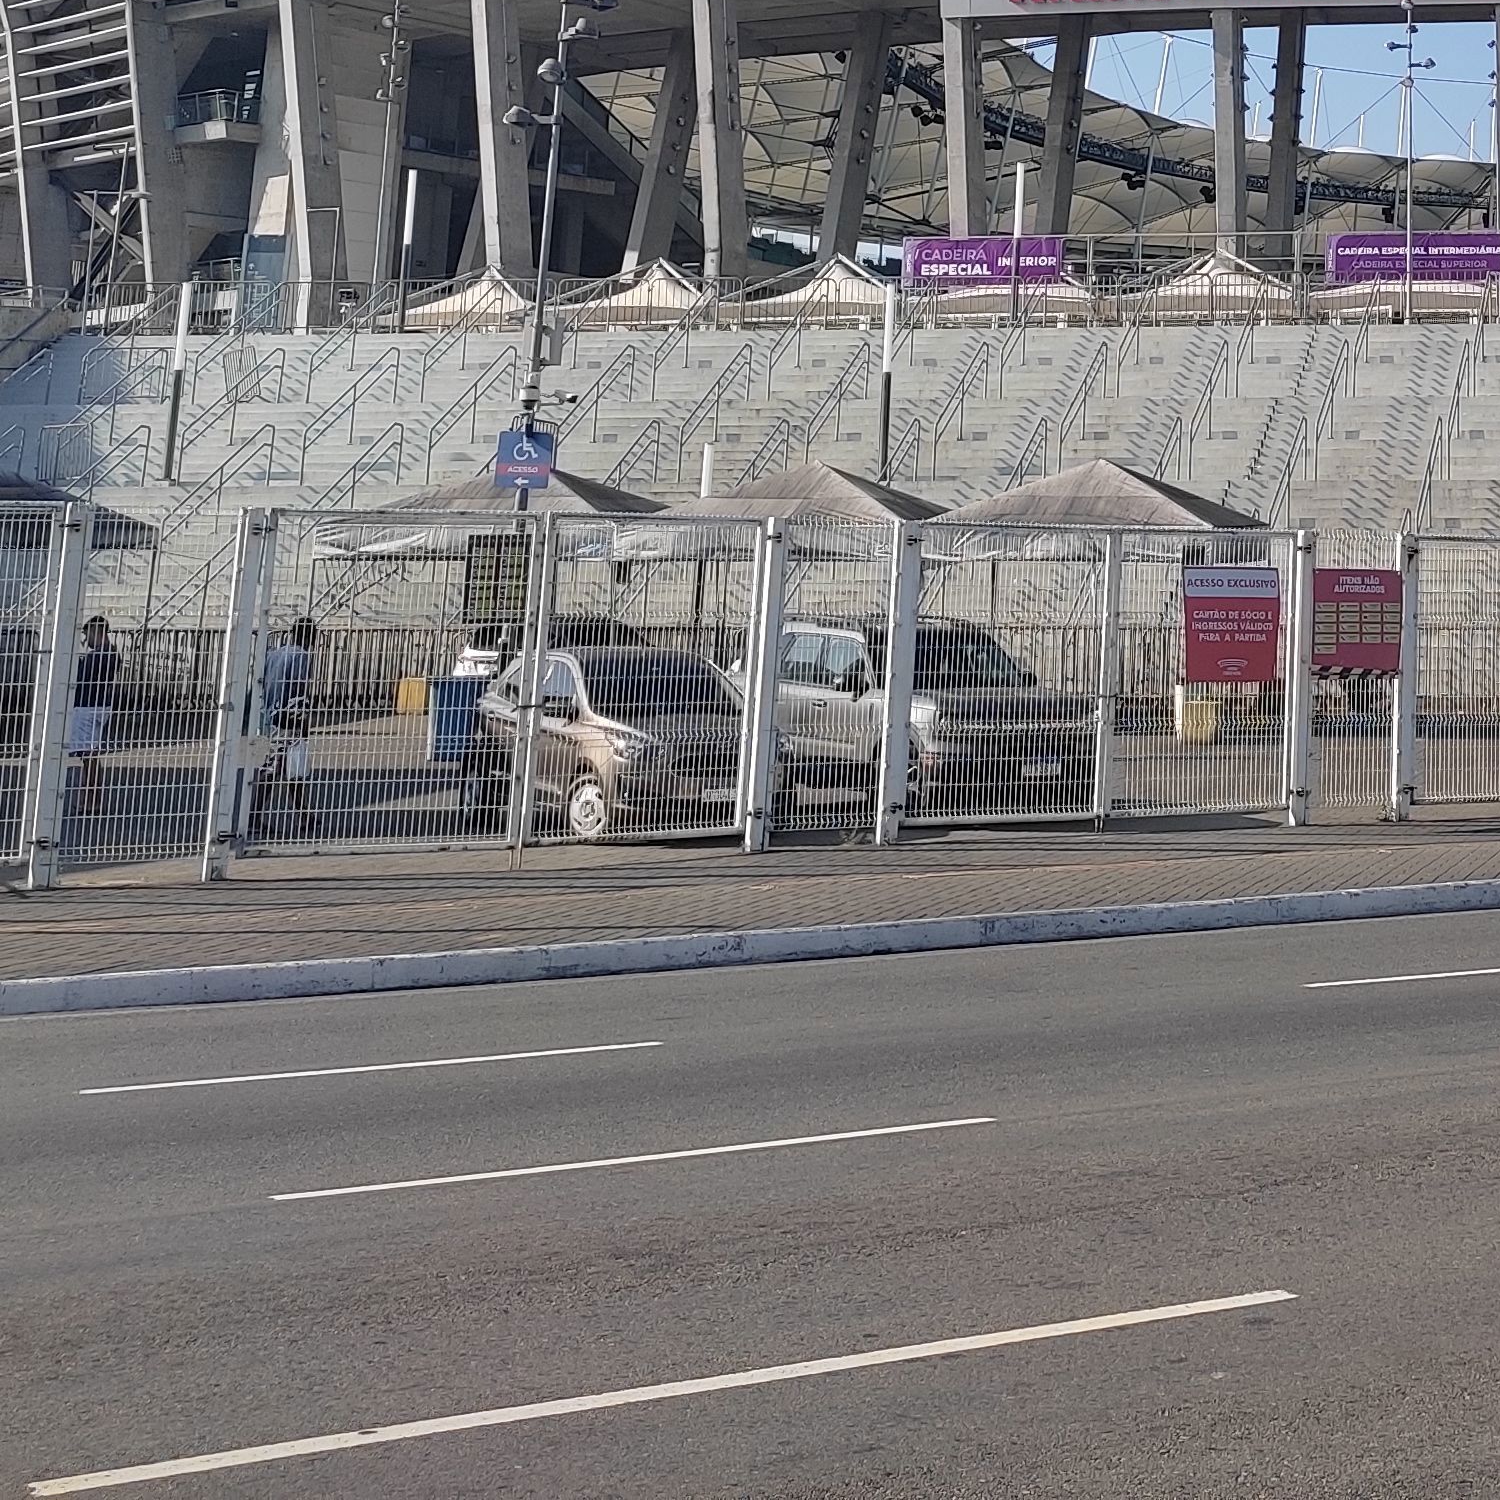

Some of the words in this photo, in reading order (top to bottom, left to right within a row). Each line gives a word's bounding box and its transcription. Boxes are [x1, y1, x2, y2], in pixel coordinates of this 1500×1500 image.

[921, 249, 987, 261] CADEIRA
[1337, 246, 1379, 256] CADEIRA
[997, 256, 1057, 267] INERIOR
[1352, 260, 1393, 269] CADEIRA
[1395, 260, 1440, 269] ESECIAL
[1440, 260, 1488, 269] SUPERIOR
[921, 263, 992, 276] ESPECIAL
[507, 465, 539, 474] ACESSO
[1186, 578, 1224, 589] ACESSO
[1227, 579, 1277, 590] EXCLUSIVO
[1339, 576, 1362, 585] ITENS
[1363, 574, 1380, 585] NÃO
[1333, 584, 1385, 594] AUTORIZADOS
[1193, 609, 1227, 619] CARTÃO
[1228, 610, 1240, 619] DE
[1267, 611, 1273, 619] E
[1191, 622, 1239, 631] INGRESSOS
[1240, 621, 1274, 631] VÁLIDOS
[1199, 633, 1221, 642] PARA
[1224, 633, 1231, 642] A
[1234, 633, 1267, 642] PARTIDA
